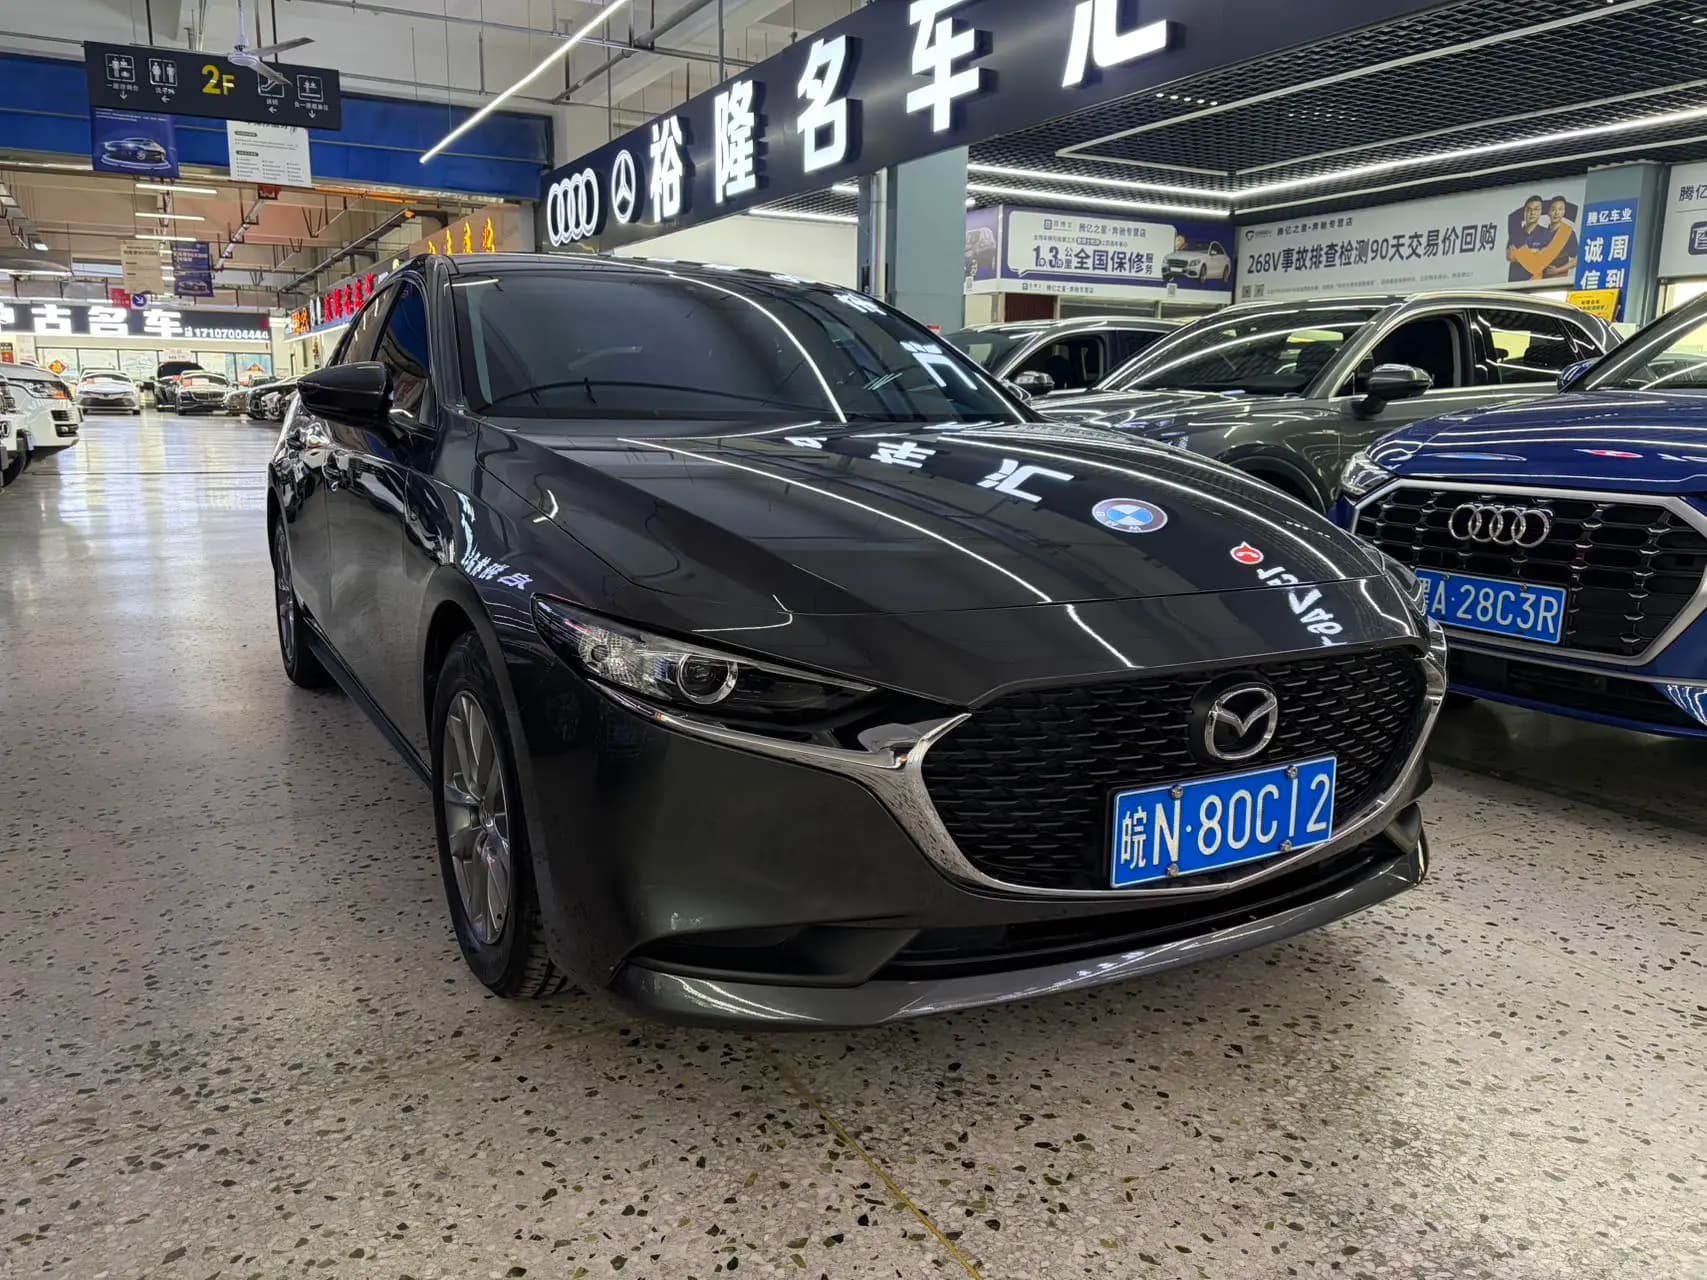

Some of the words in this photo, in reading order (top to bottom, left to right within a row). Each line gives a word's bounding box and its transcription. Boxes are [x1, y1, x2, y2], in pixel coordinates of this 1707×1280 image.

[201, 64, 236, 95] 2F
[1587, 207, 1632, 224] 腾亿车业
[1247, 221, 1498, 275] 268V事故排查检测90天交易价回购
[0, 303, 183, 338] 古名车
[1120, 773, 1331, 870] 皖N·80C12
